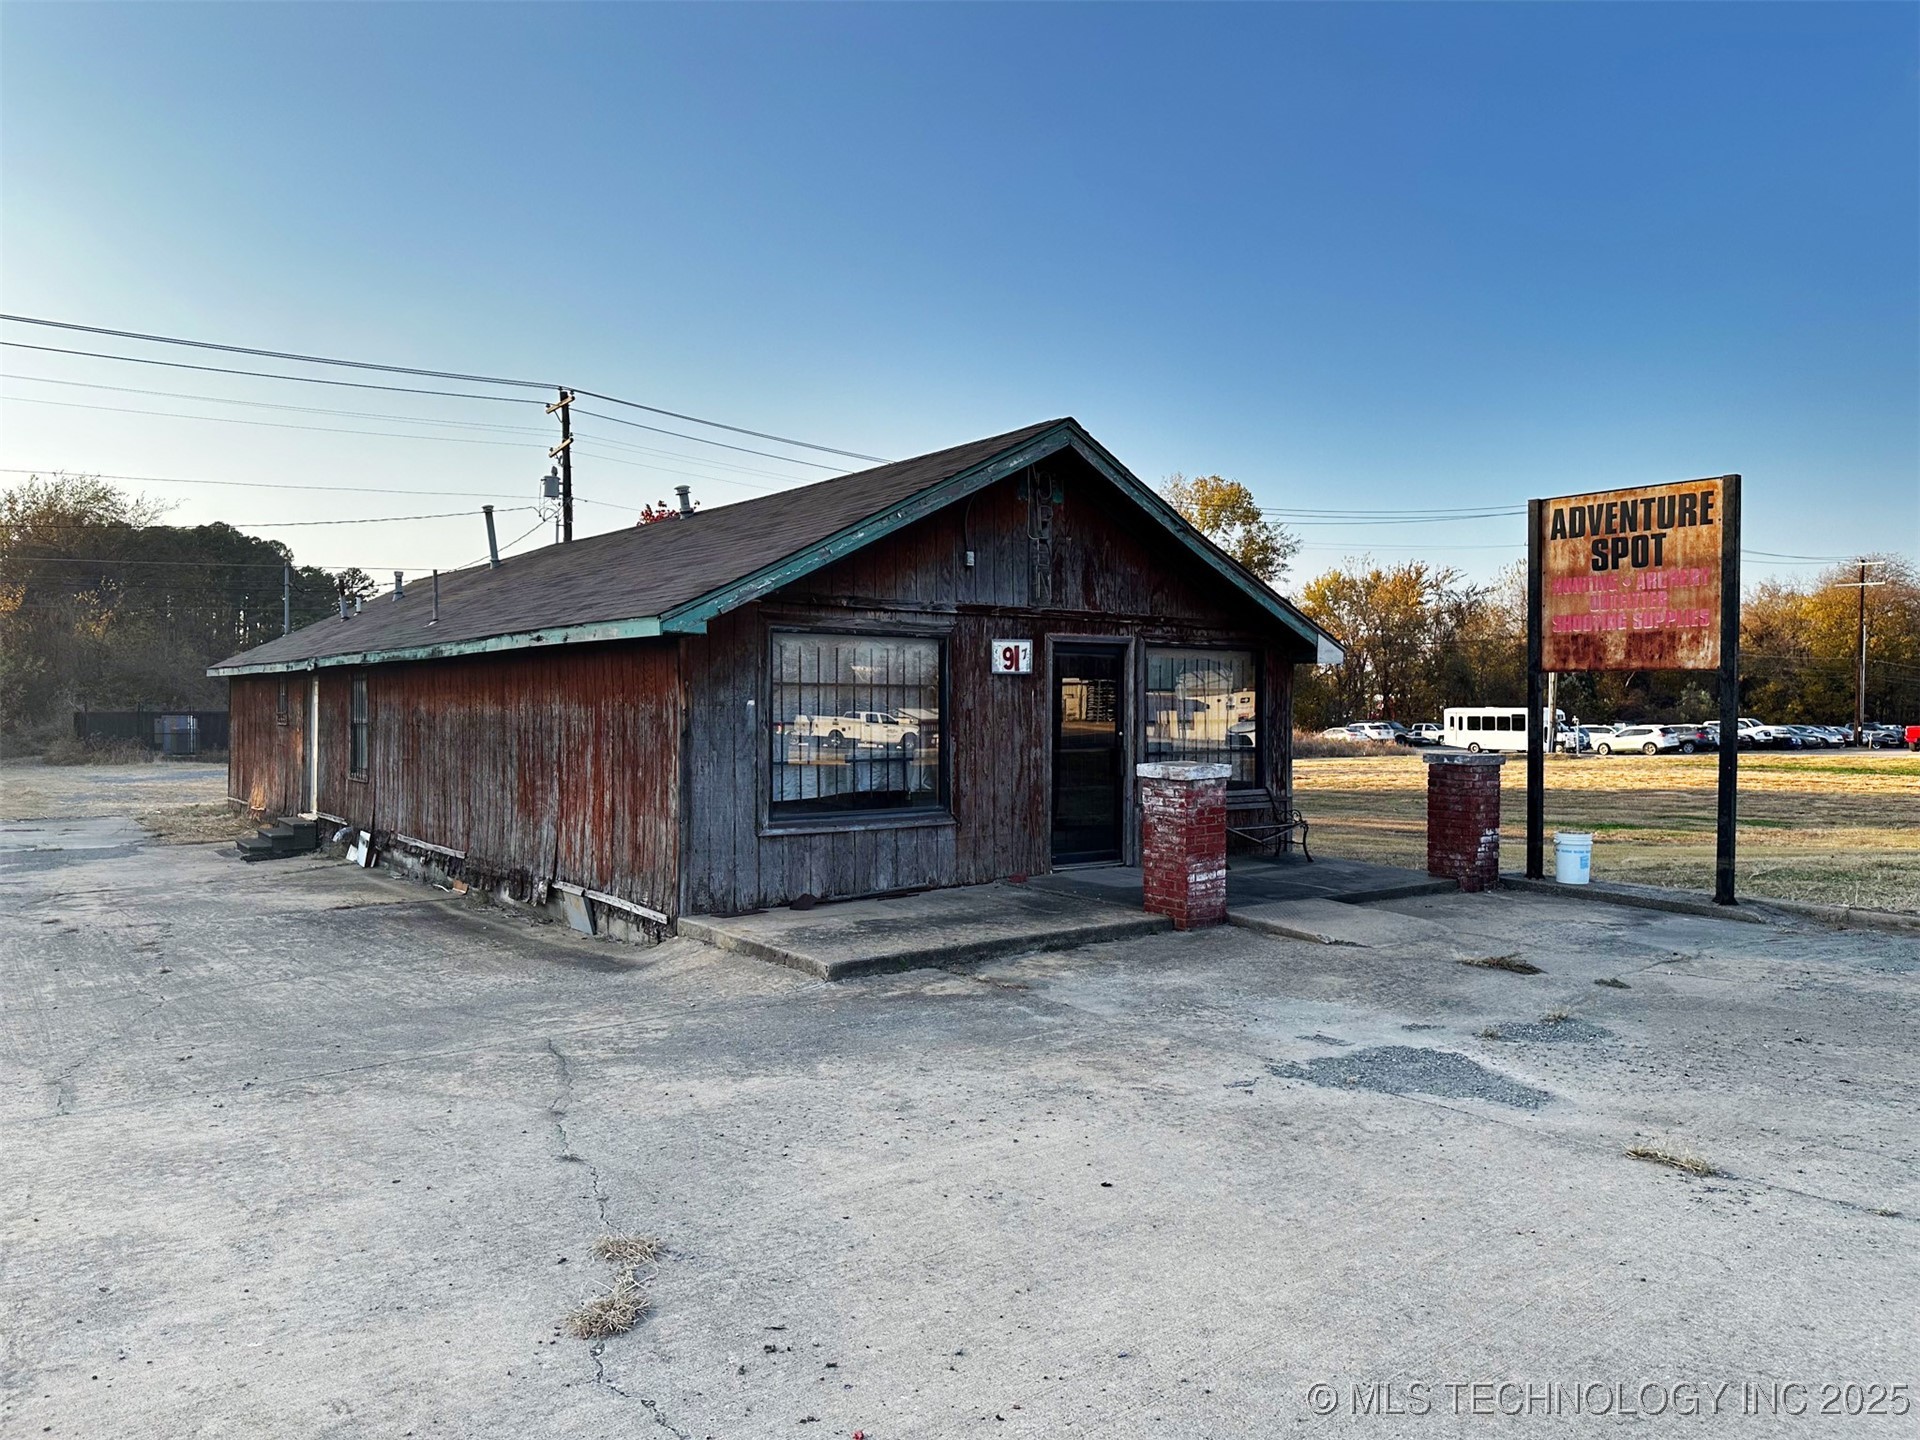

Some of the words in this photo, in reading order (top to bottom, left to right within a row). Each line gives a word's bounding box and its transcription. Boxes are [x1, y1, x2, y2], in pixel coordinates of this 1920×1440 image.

[1551, 491, 1714, 541] ADVENTURE
[1591, 533, 1667, 571] SPOT
[1636, 567, 1711, 590] ARCHERY
[1632, 608, 1711, 630] SUPPLIES
